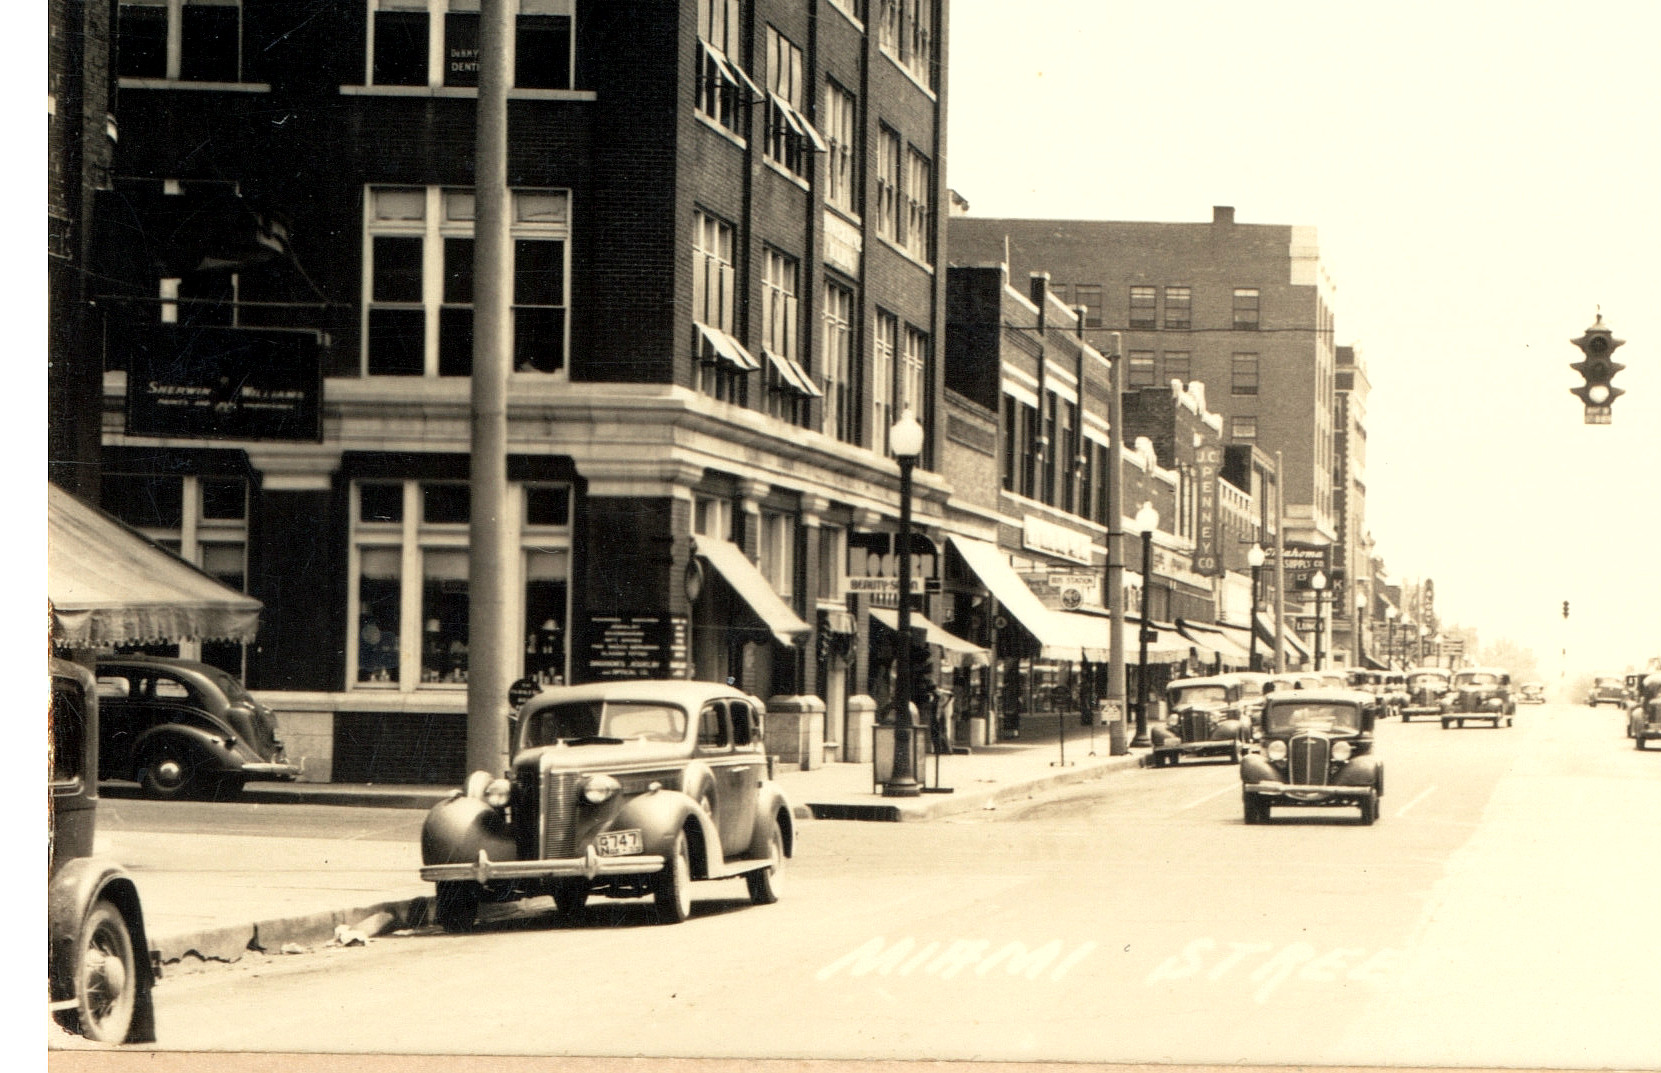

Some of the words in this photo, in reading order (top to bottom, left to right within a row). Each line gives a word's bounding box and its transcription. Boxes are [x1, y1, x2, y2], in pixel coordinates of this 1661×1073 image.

[451, 61, 481, 72] DENTI
[1201, 466, 1213, 553] PENNEY
[1197, 557, 1215, 569] CO
